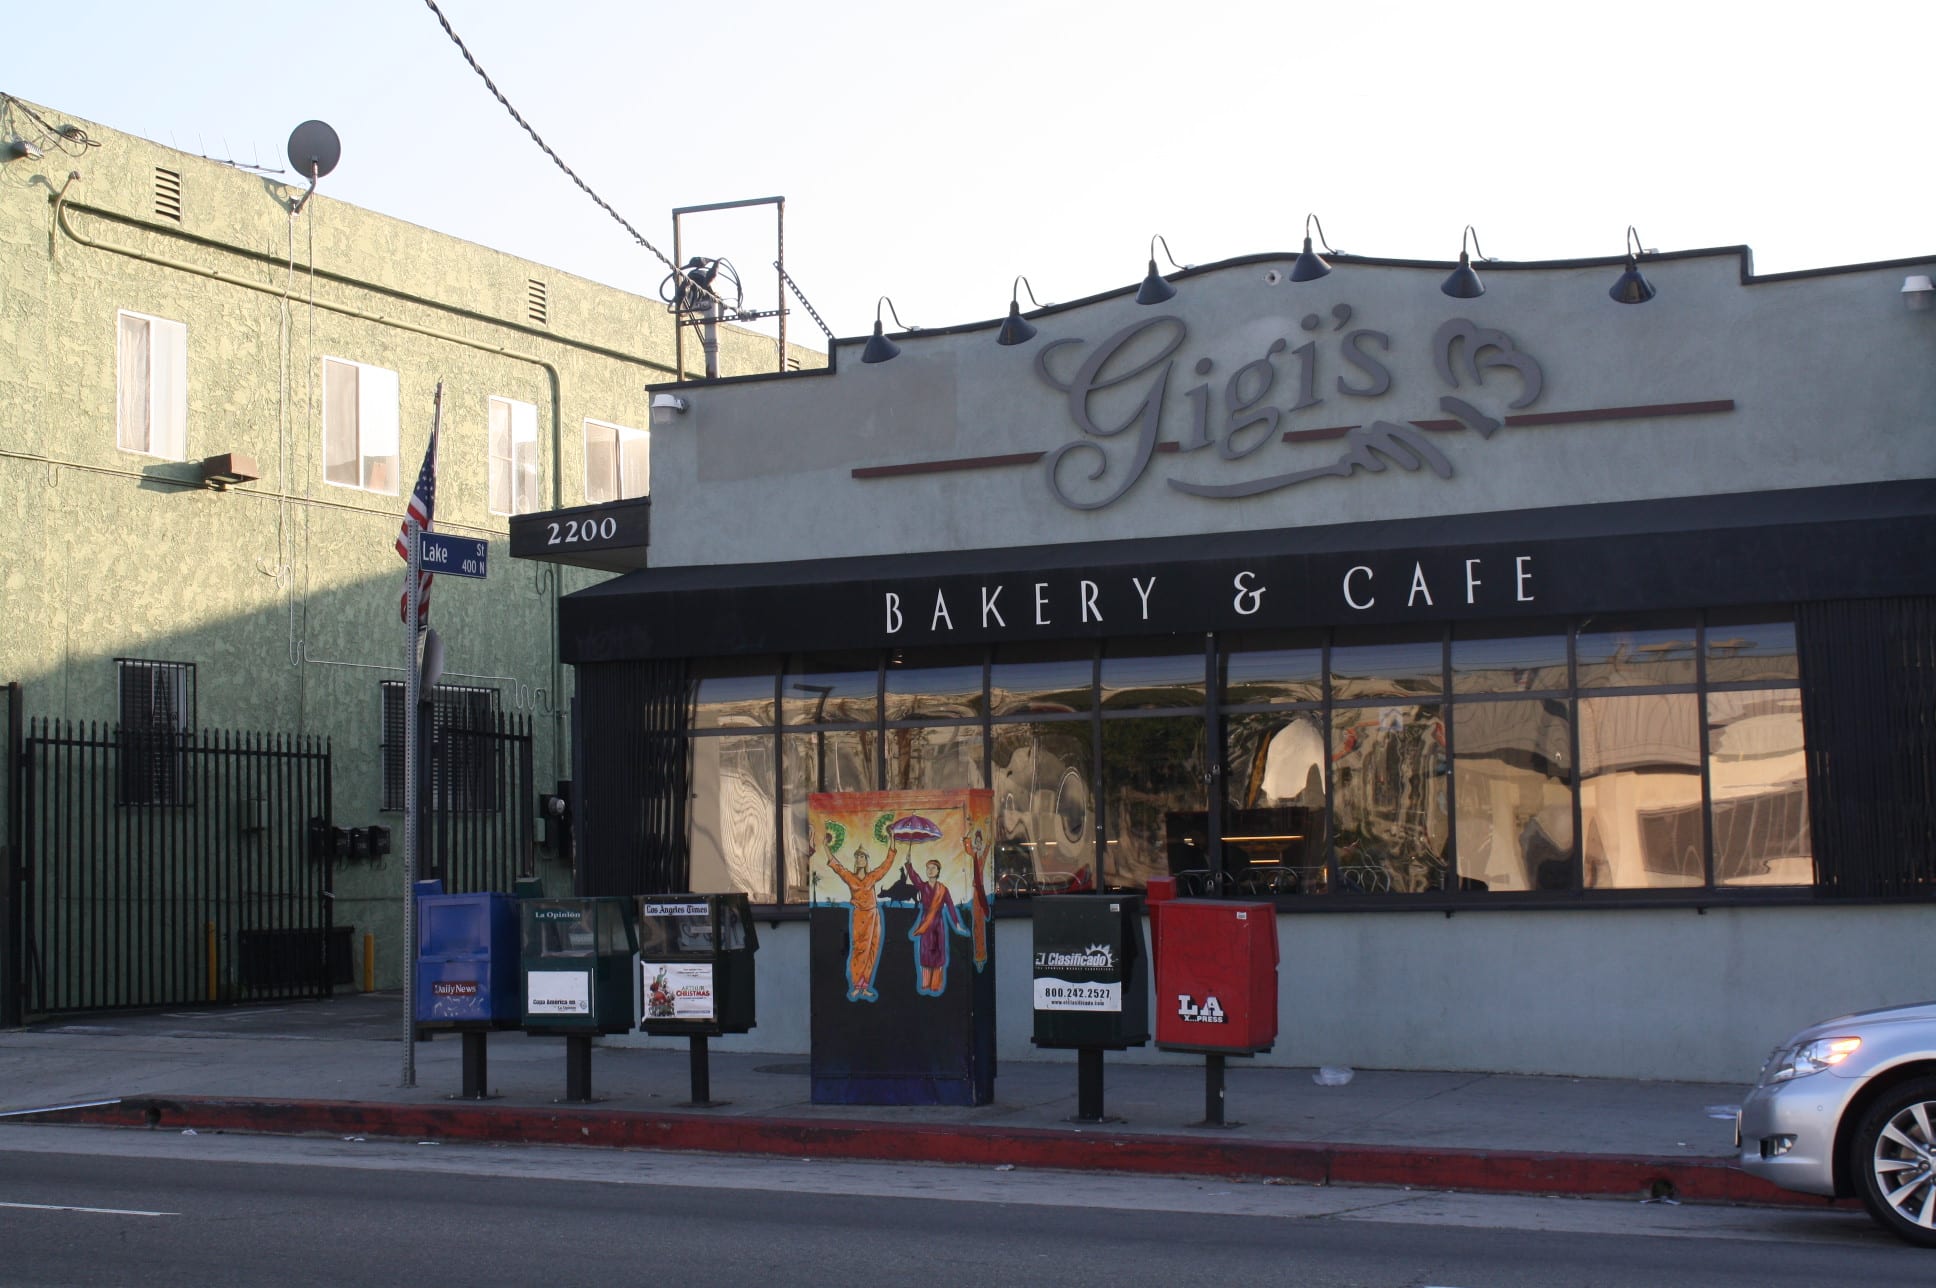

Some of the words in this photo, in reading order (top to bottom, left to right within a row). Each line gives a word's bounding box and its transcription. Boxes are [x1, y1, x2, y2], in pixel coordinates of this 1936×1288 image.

[1034, 303, 1391, 511] Gigi's
[547, 517, 617, 546] 2200
[423, 540, 448, 563] Lake
[476, 543, 485, 557] St
[461, 559, 477, 573] 400
[479, 561, 485, 574] N
[885, 576, 1156, 634] BAKERY
[1233, 571, 1266, 615] &
[1343, 556, 1535, 610] CAFE
[646, 904, 658, 914] Los
[659, 904, 685, 916] Angeles
[687, 904, 708, 914] Times
[1047, 952, 1107, 967] Clasificado
[455, 984, 477, 993] News
[1045, 987, 1110, 998] 800.242.2527
[1178, 994, 1224, 1017] LA
